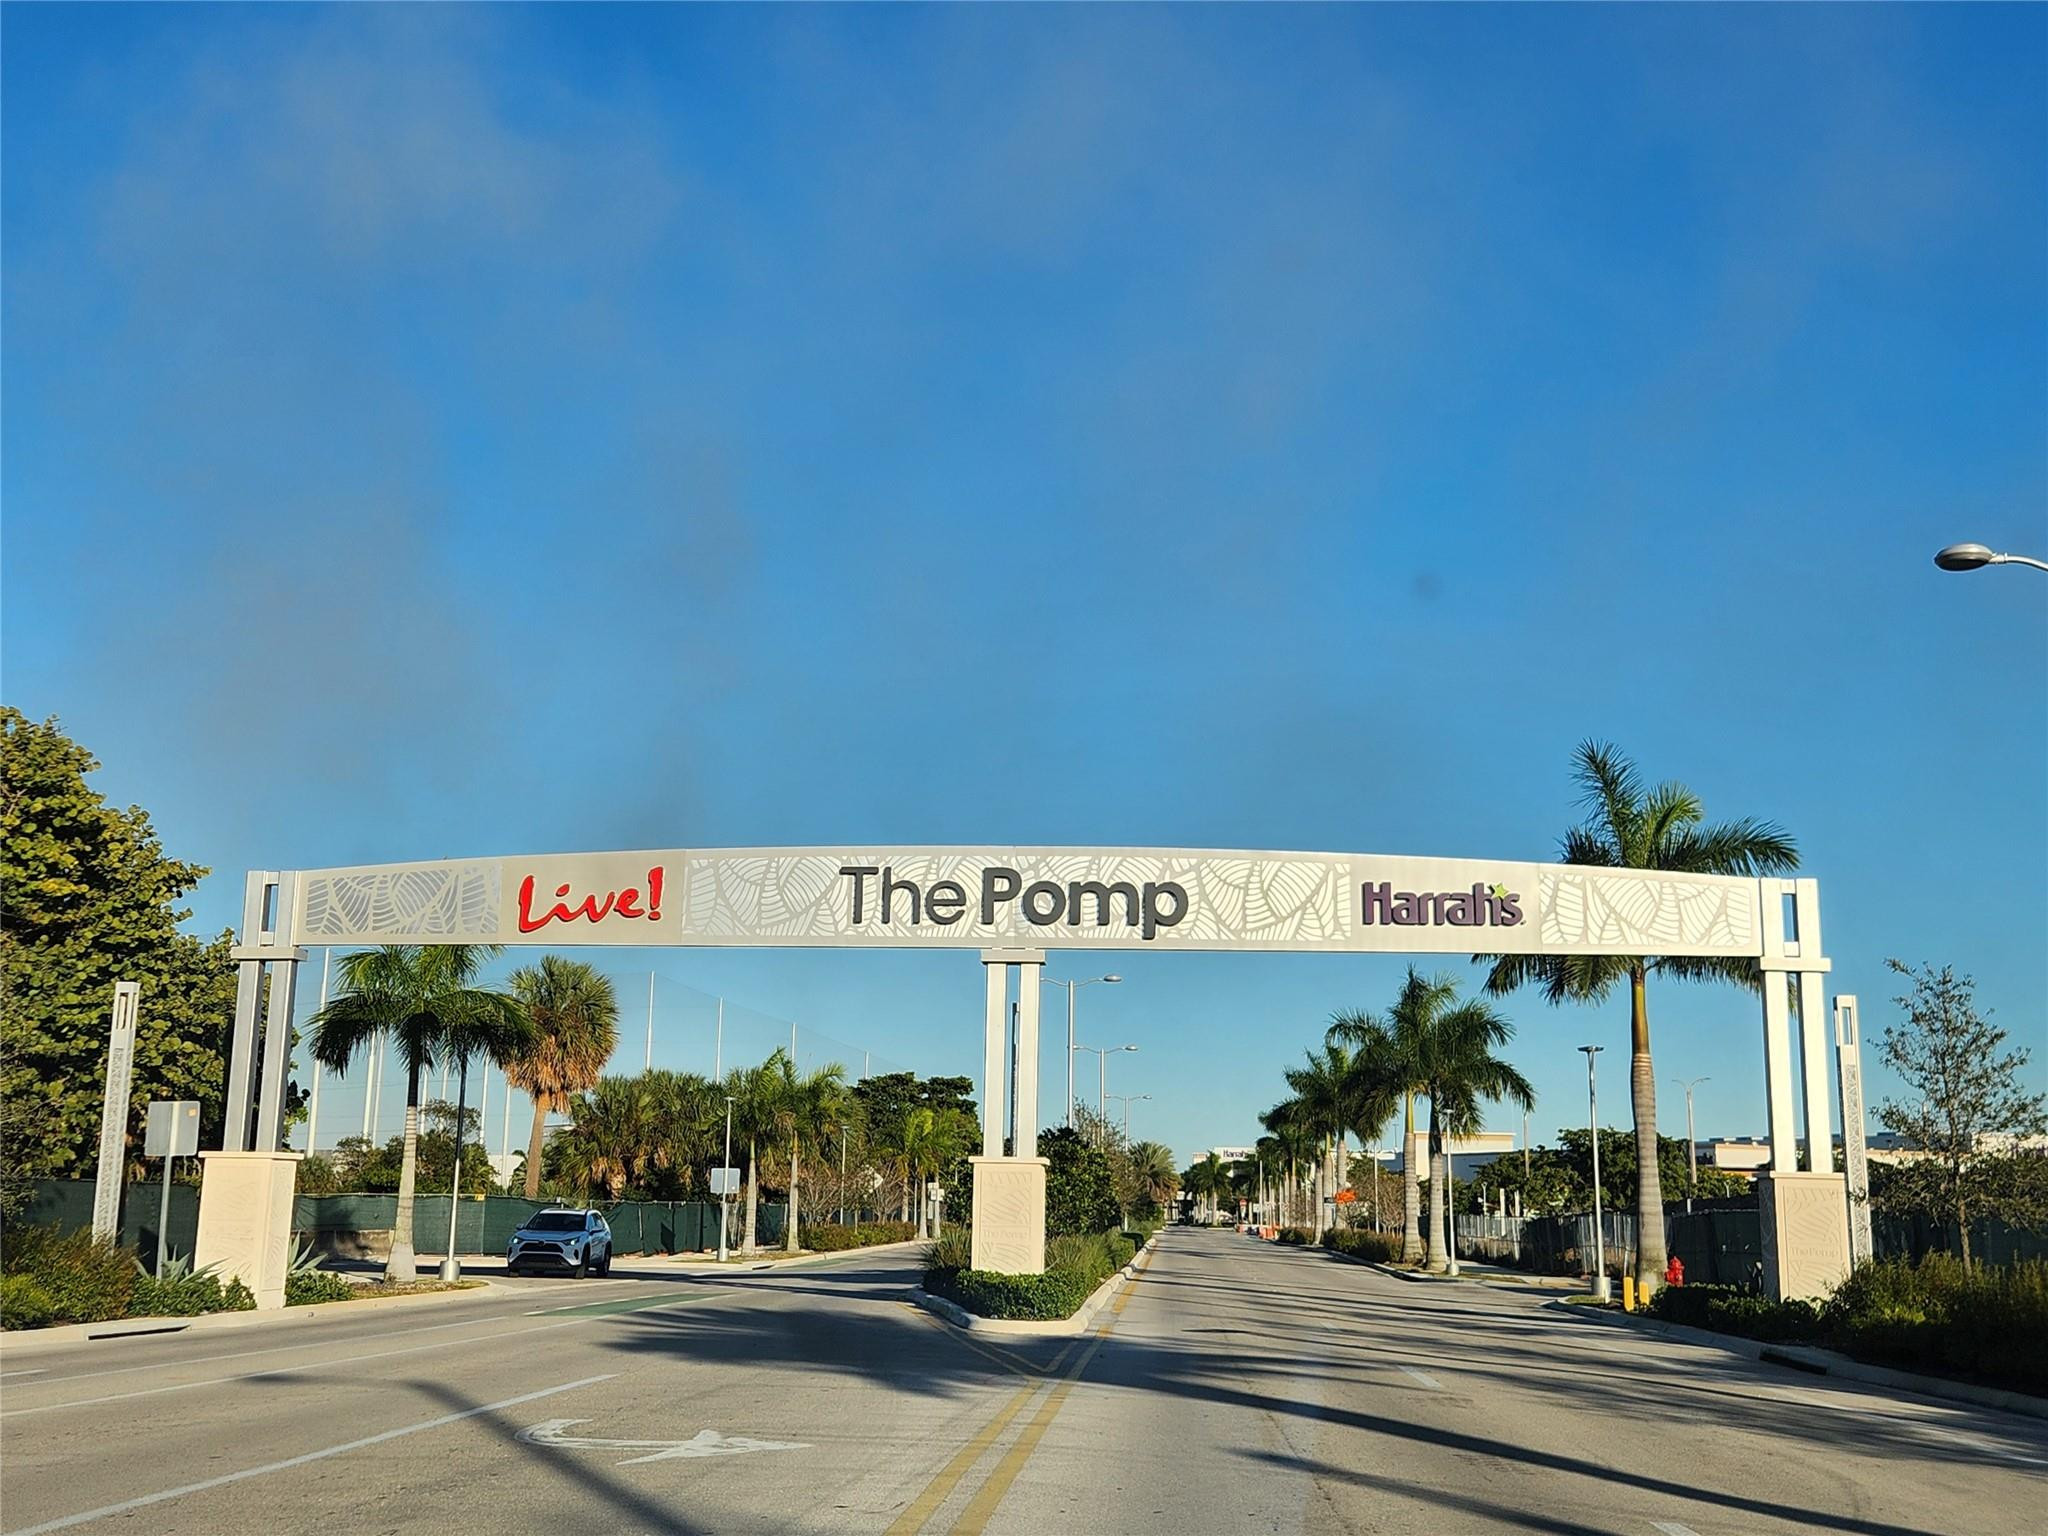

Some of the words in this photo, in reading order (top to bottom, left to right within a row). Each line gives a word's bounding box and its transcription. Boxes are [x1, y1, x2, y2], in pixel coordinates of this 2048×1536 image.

[517, 865, 665, 934] Live!
[839, 866, 967, 926] The
[980, 866, 1189, 941] Pomp
